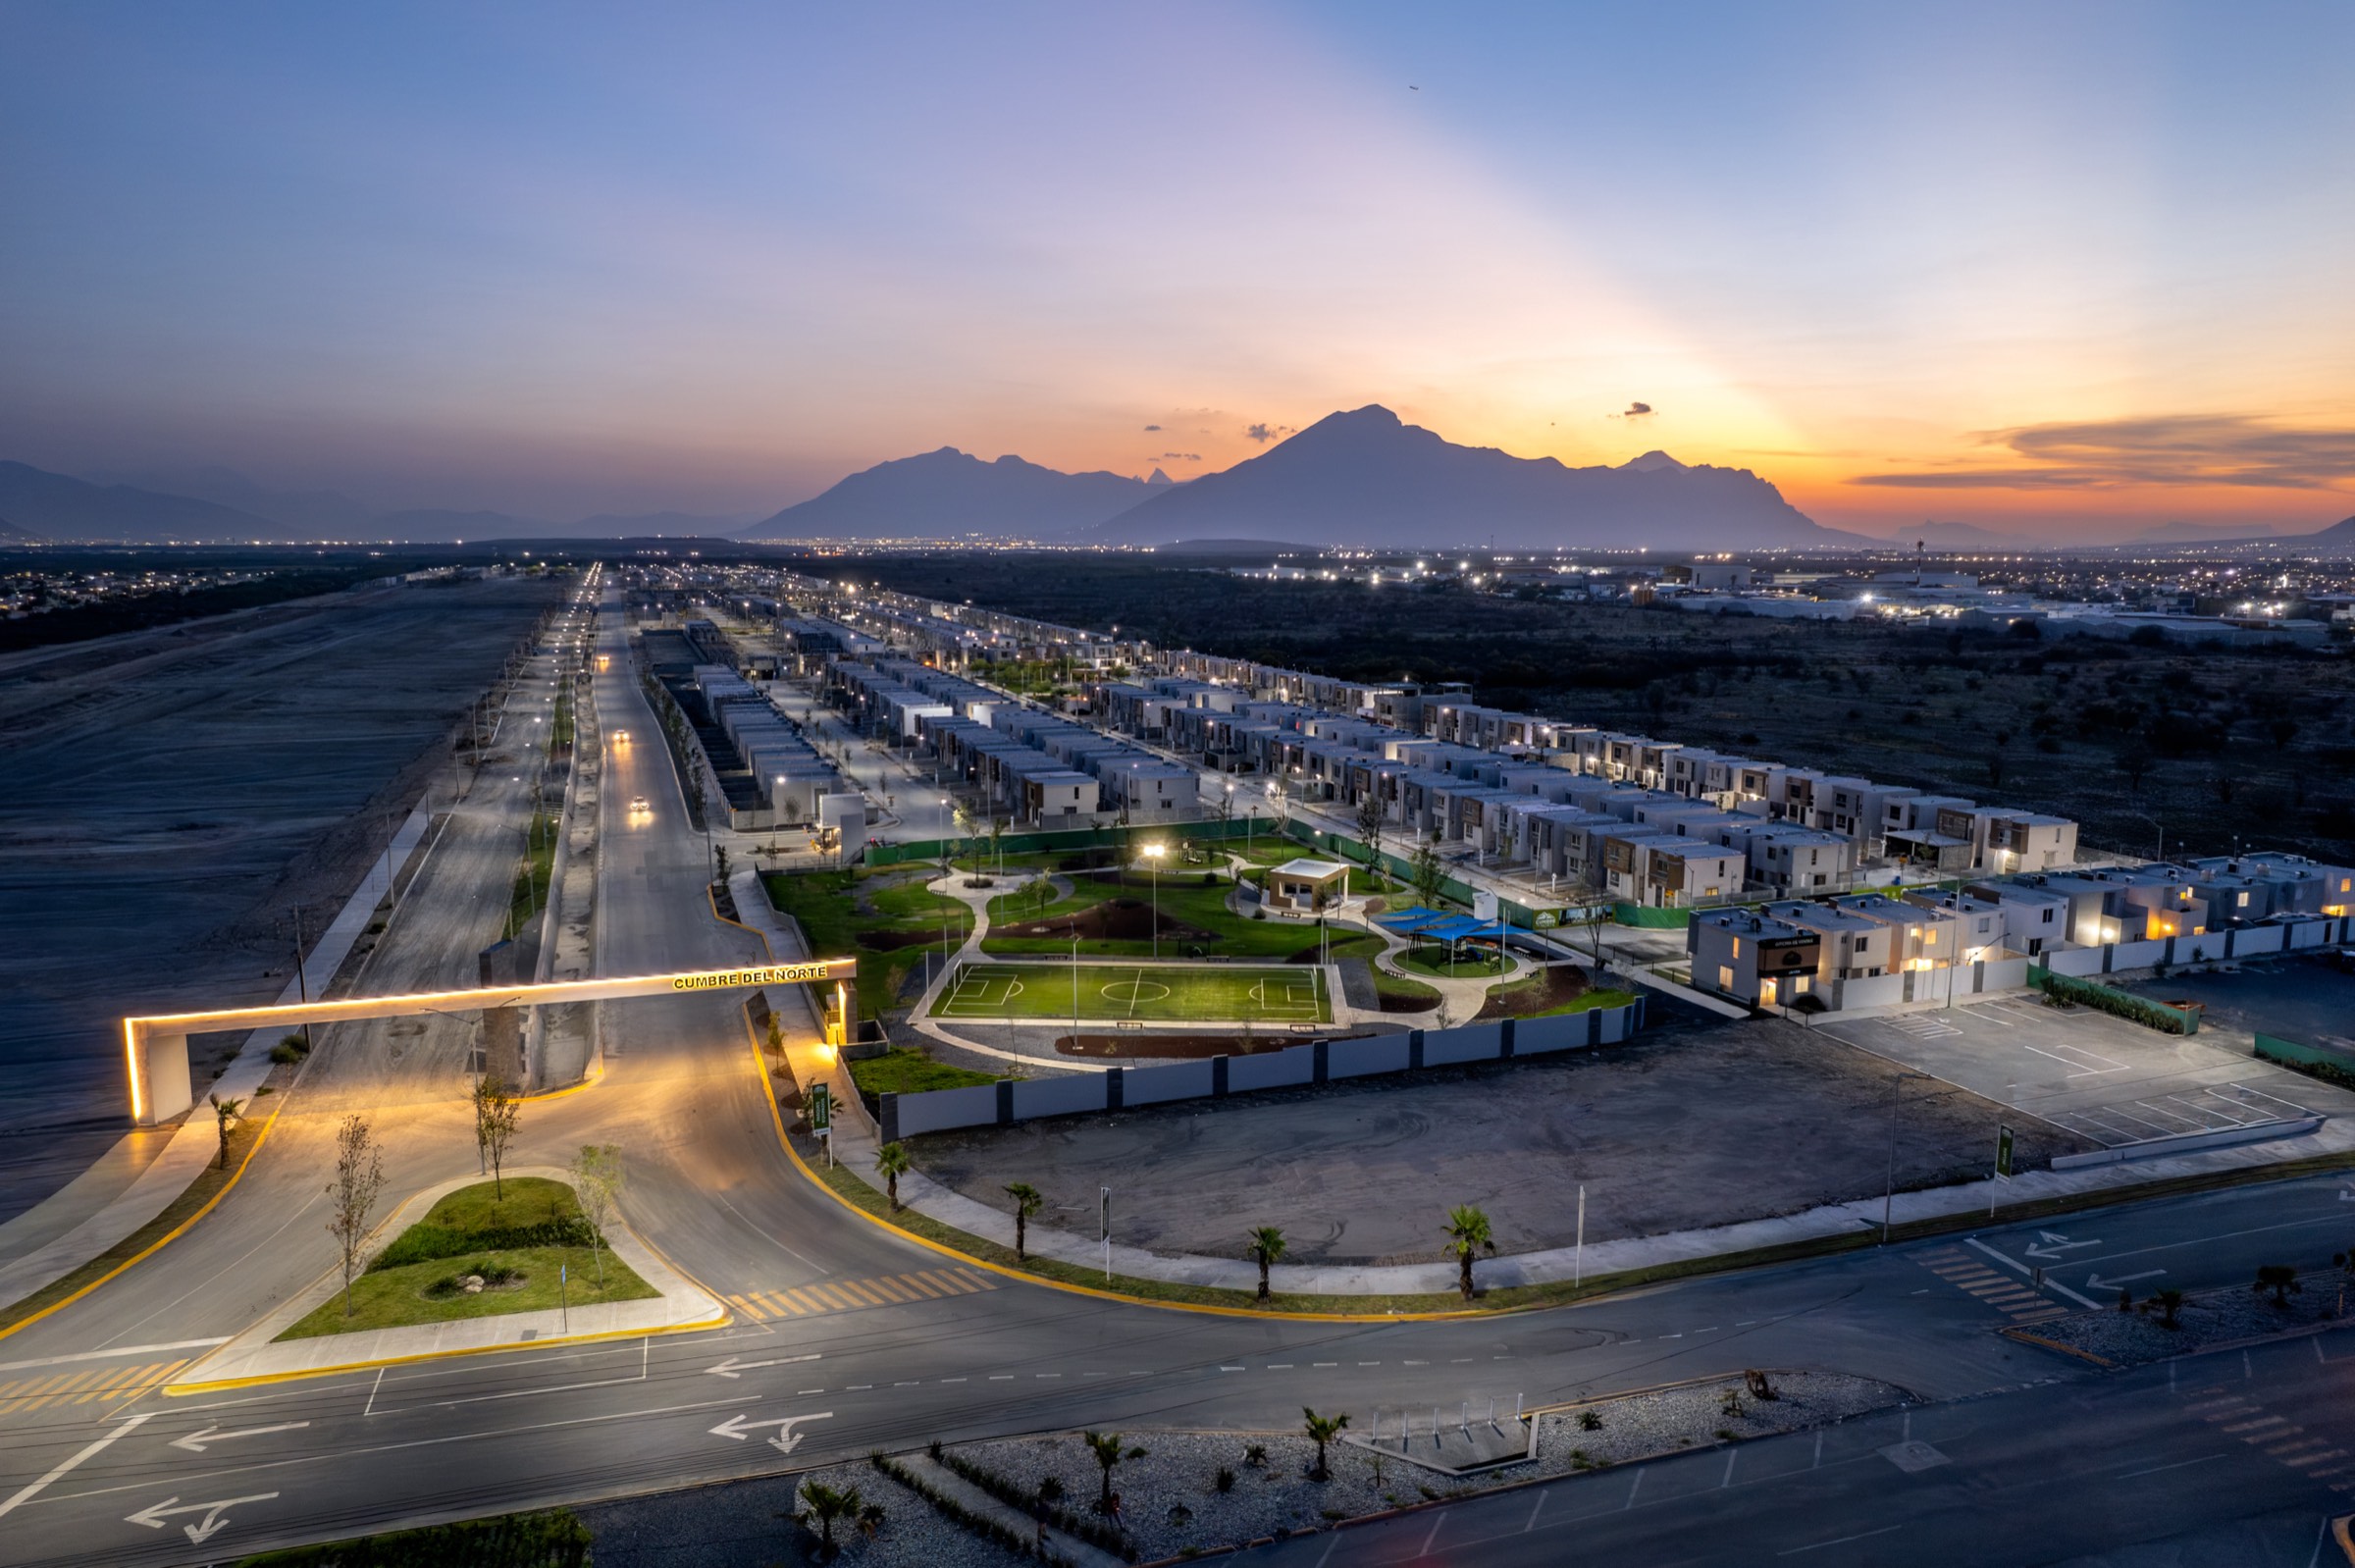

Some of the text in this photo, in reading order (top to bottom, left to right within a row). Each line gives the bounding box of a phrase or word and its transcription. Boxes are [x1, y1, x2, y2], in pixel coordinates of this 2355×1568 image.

[674, 967, 827, 988] CUMBRE DEL NORTE
